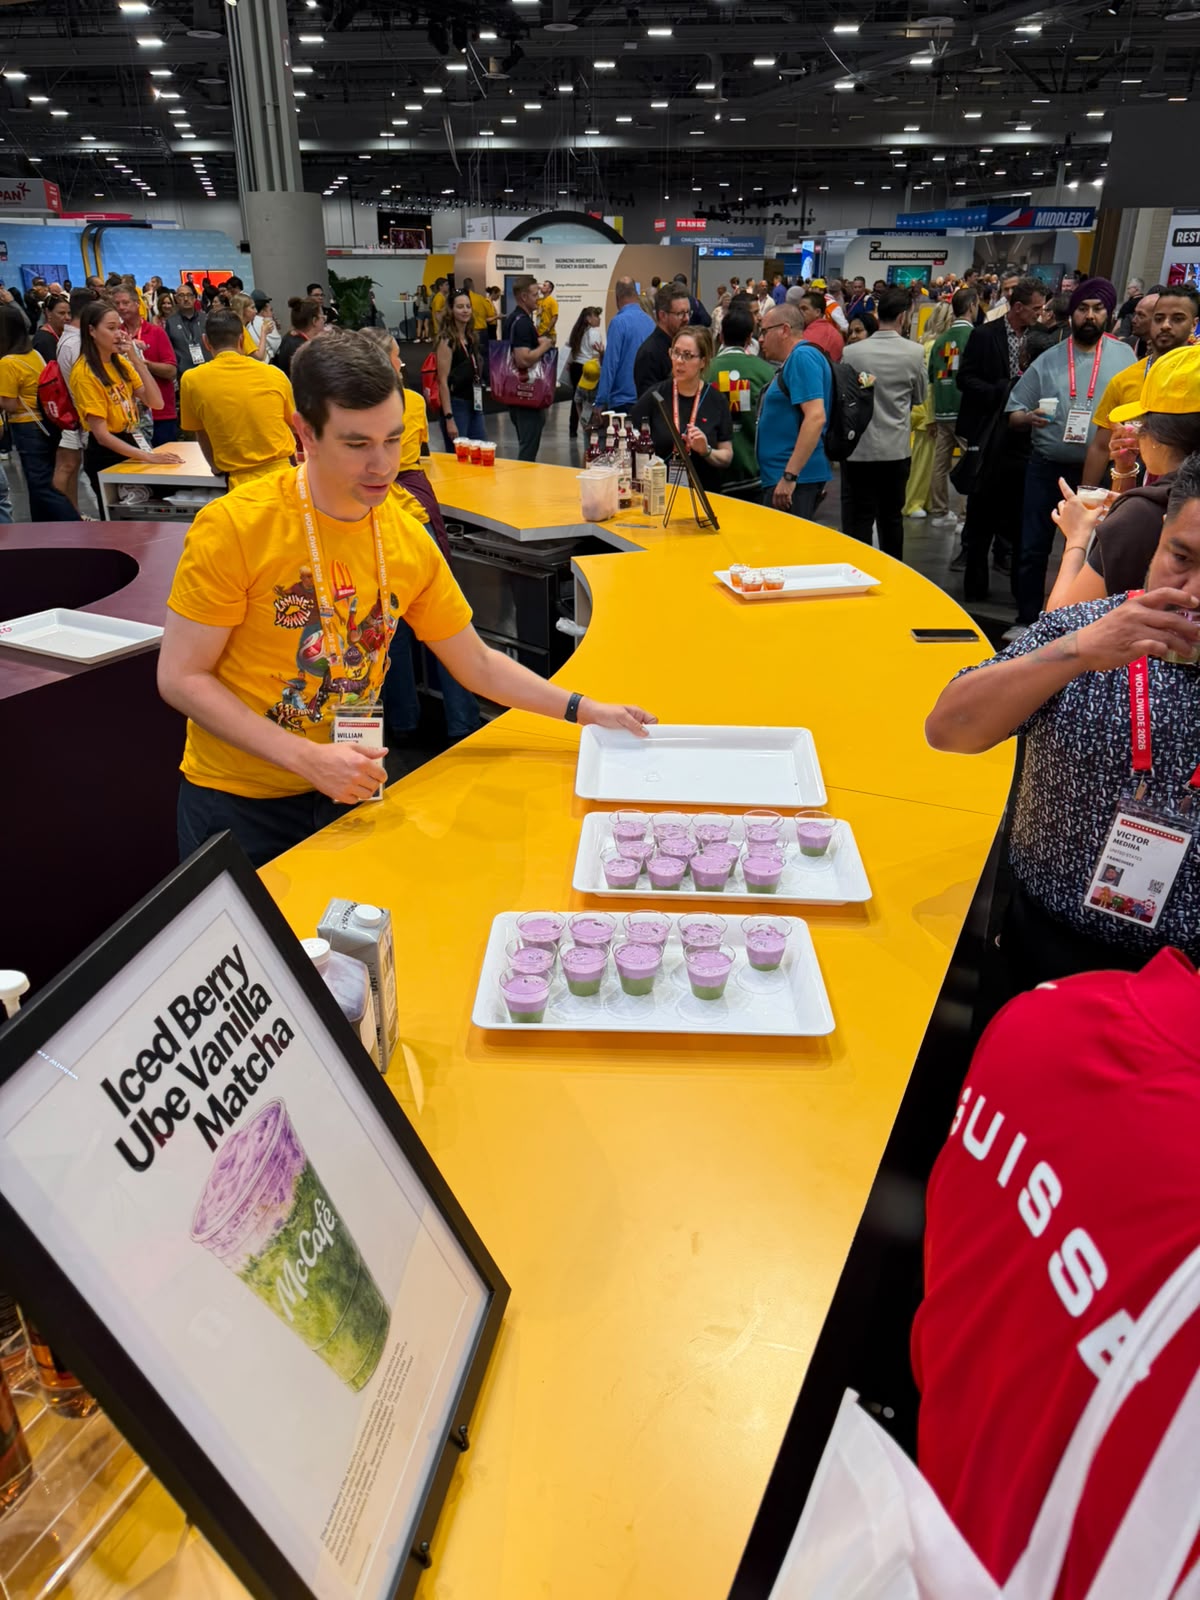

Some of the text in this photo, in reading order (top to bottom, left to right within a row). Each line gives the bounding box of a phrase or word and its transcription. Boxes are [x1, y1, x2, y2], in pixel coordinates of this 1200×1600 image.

[1035, 212, 1090, 227] MIDDLEBY
[1176, 231, 1200, 243] REST
[304, 512, 320, 562] WORLDWIDE
[275, 594, 309, 612] LAMINE
[276, 609, 312, 628] YAMAL
[1135, 673, 1147, 750] WORLDWIDE 2026
[1113, 838, 1140, 852] MEDINA
[1117, 830, 1150, 846] VICTOR
[100, 944, 249, 1119] Iced Berry
[114, 983, 273, 1172] Ube Vanilla
[193, 1017, 295, 1152] Matcha
[277, 1198, 336, 1322] McCafé
